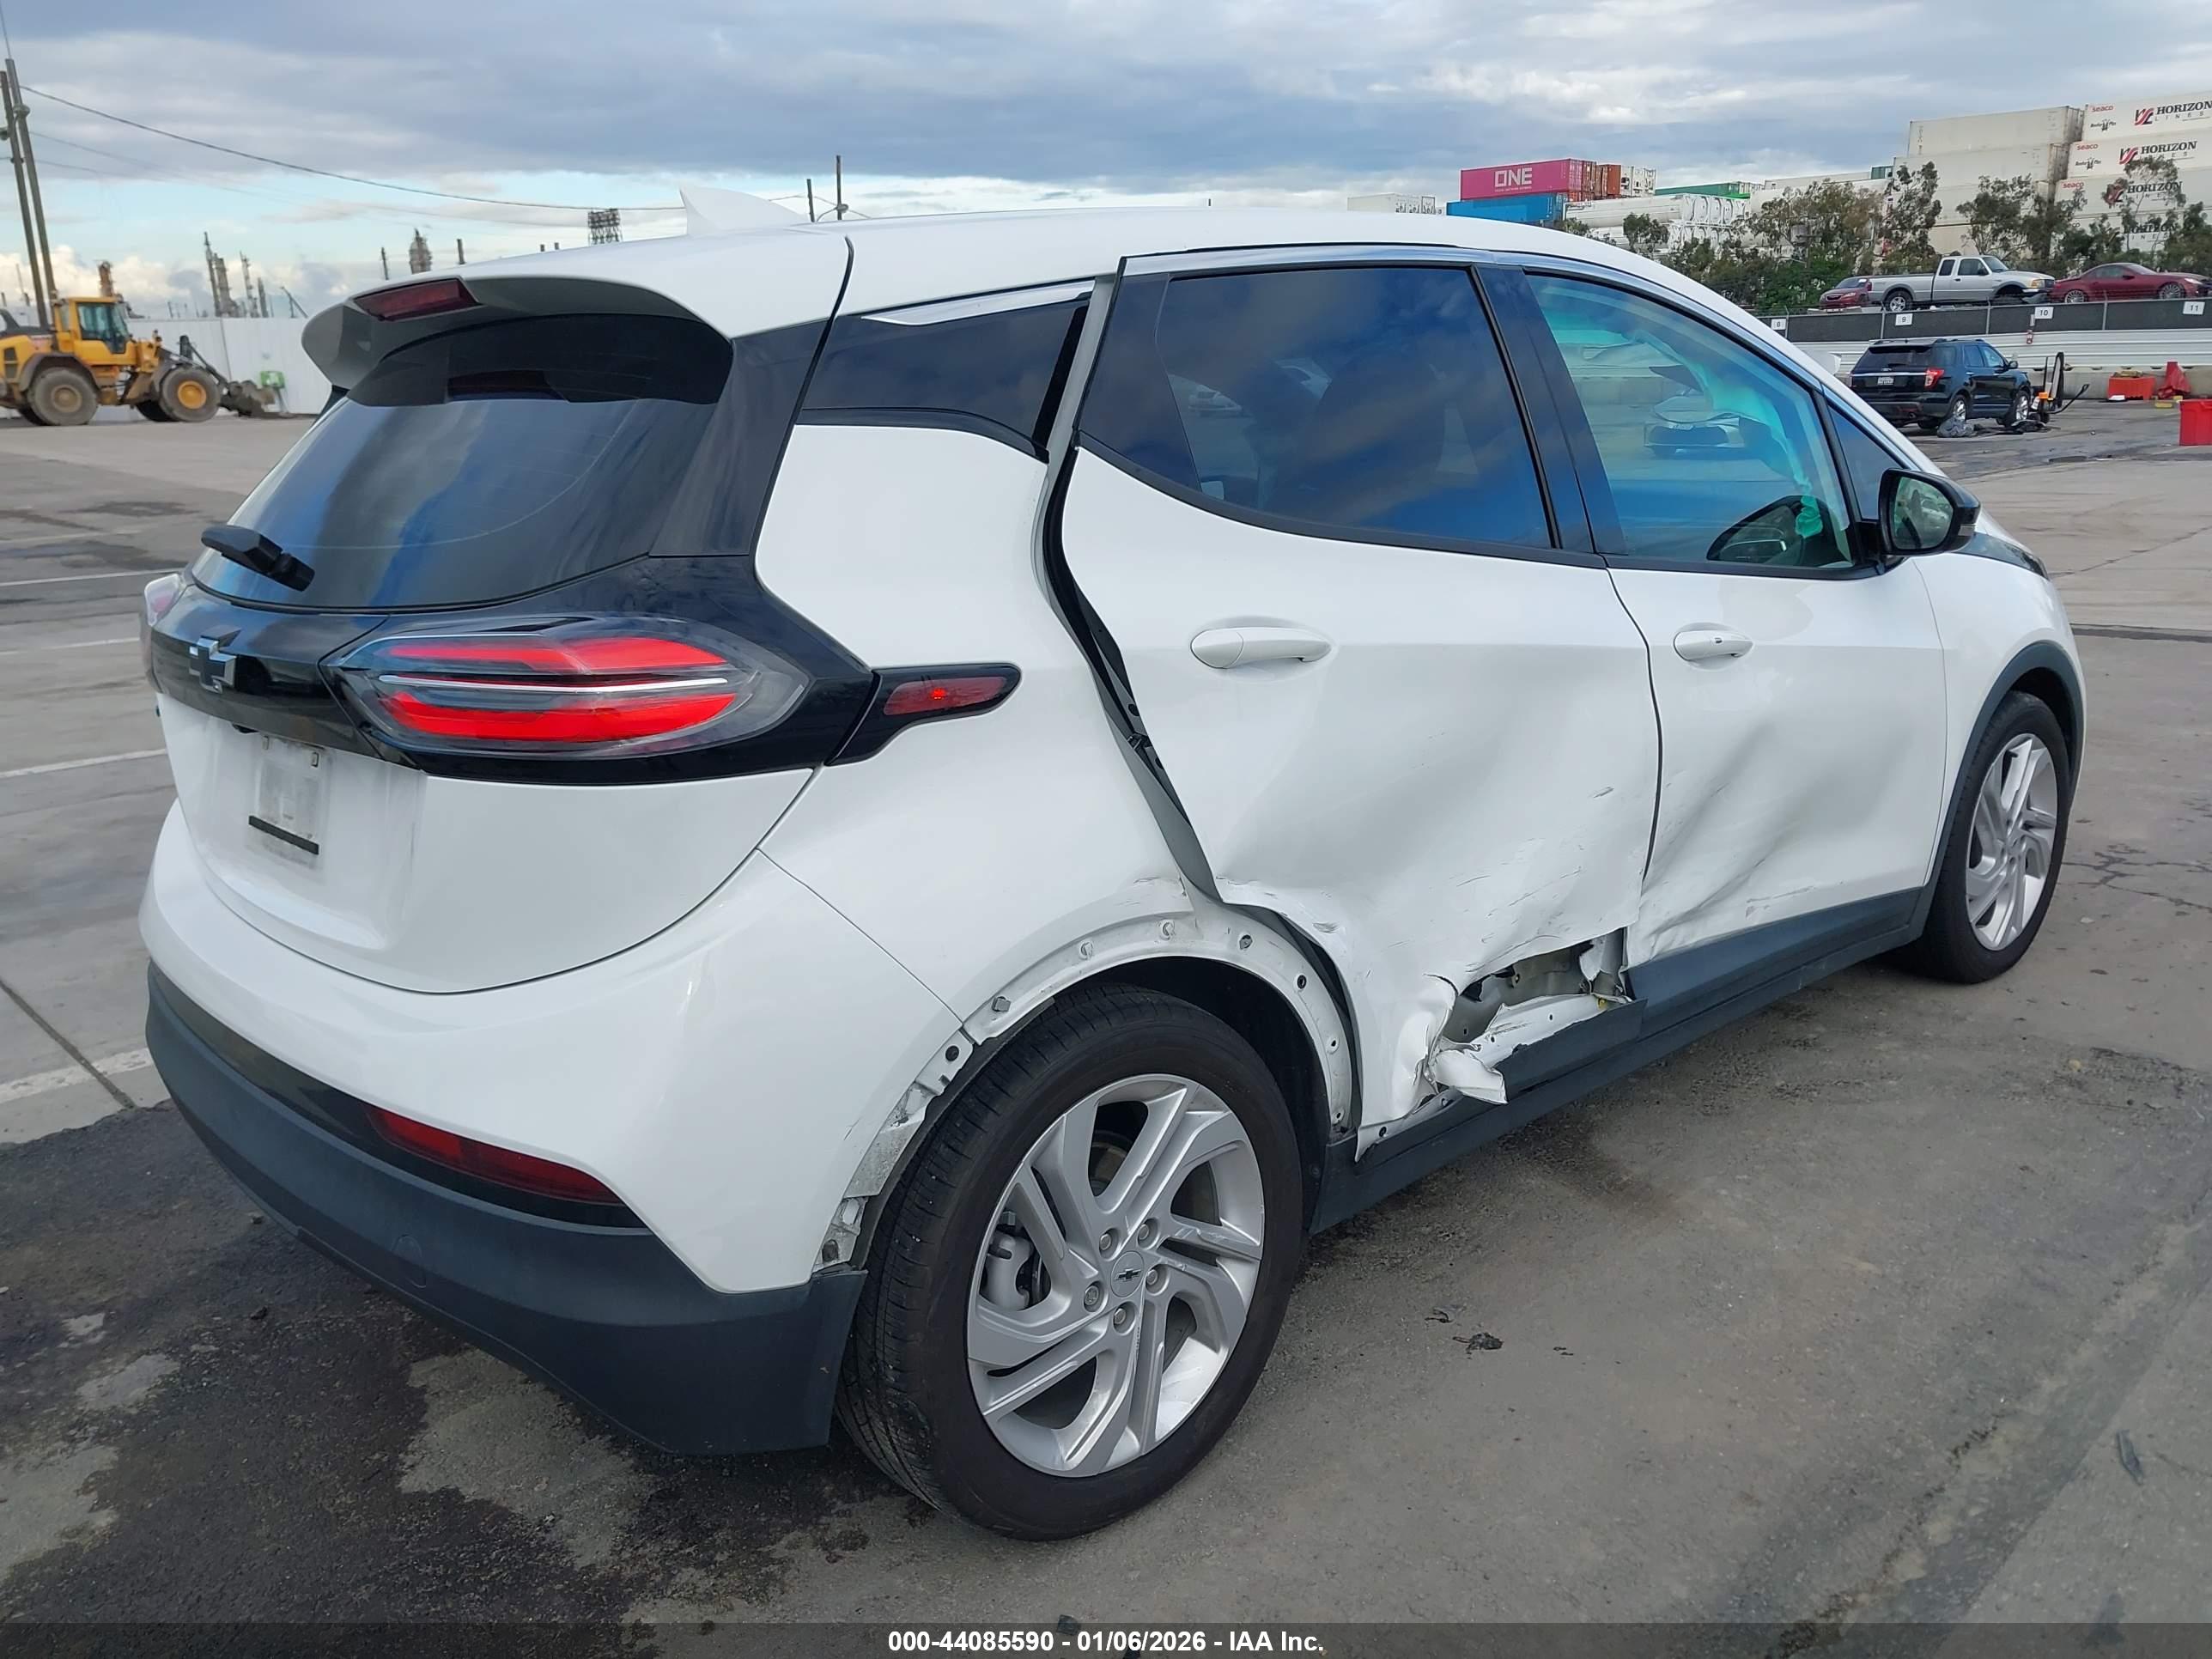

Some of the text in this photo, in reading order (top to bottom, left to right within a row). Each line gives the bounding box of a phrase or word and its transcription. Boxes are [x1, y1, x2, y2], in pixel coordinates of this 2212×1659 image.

[2156, 100, 2212, 114] HORIZON
[2141, 141, 2197, 155] HORIZON
[1494, 167, 1533, 187] ONE
